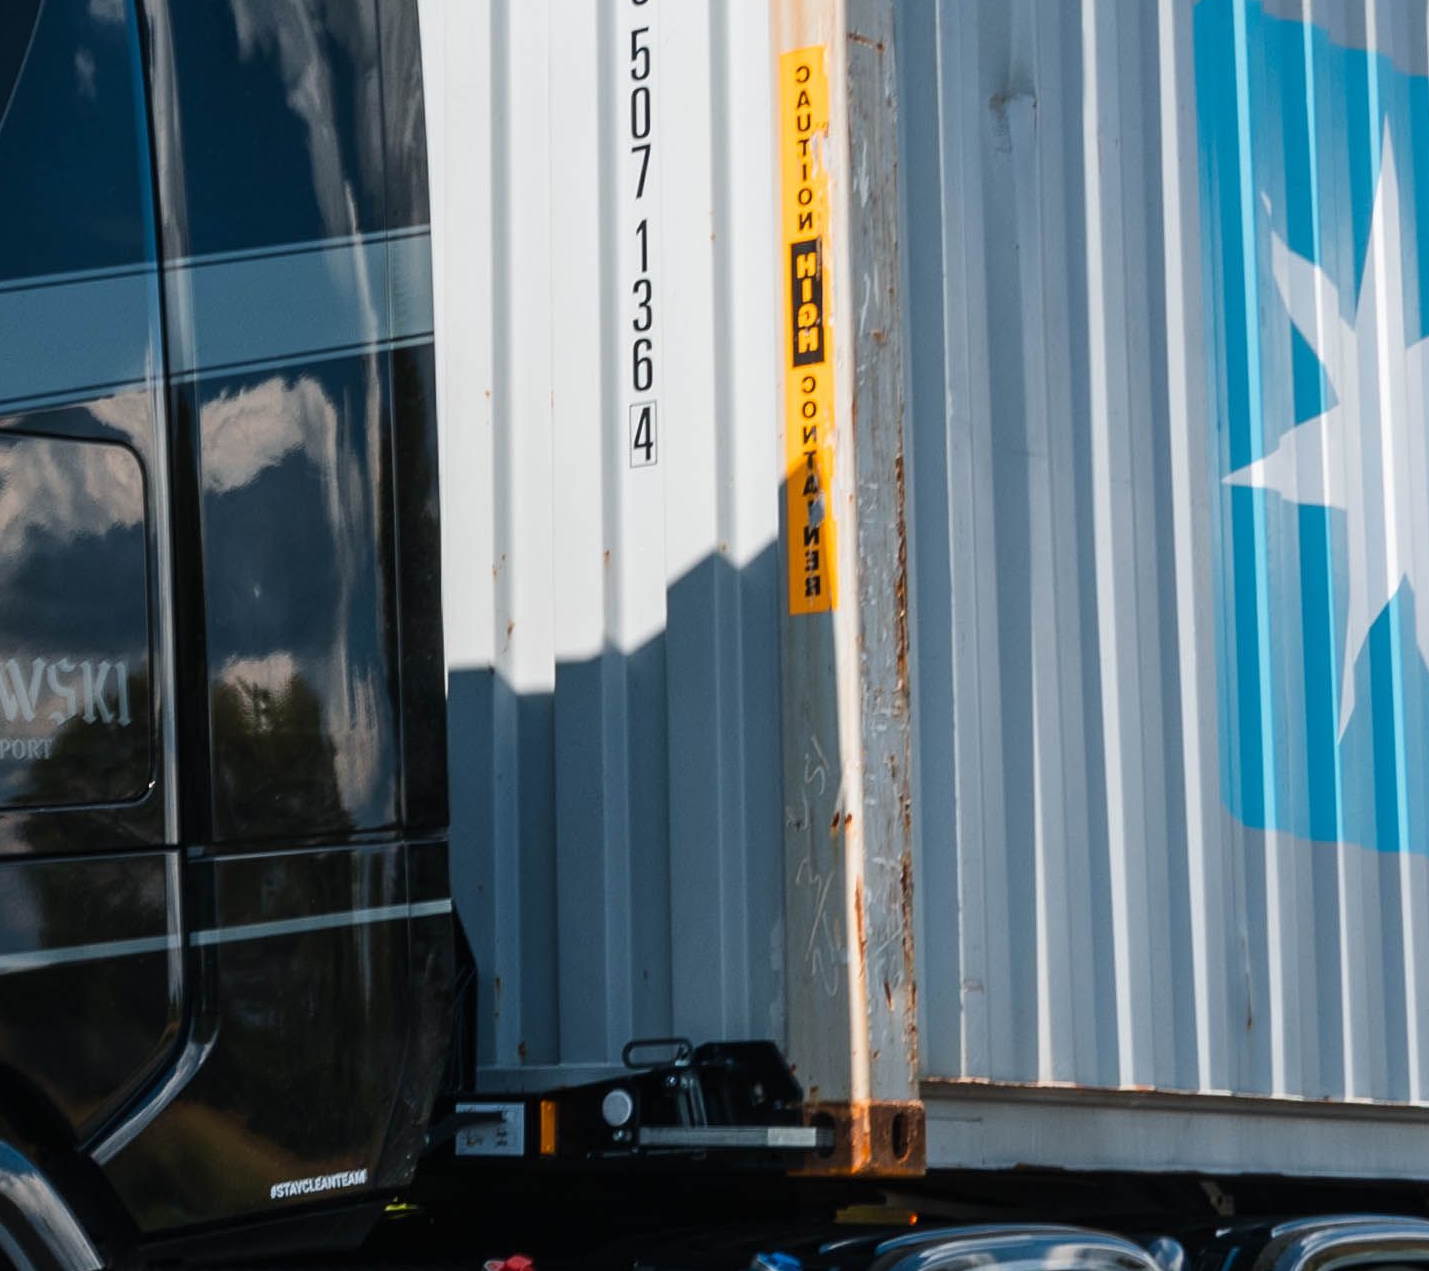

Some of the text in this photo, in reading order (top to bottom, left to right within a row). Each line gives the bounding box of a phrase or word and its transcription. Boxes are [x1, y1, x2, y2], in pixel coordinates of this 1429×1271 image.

[628, 26, 651, 201] 507
[632, 218, 653, 392] 136
[632, 405, 654, 462] 4
[270, 1169, 369, 1199] #STAYCLEANTEAM
